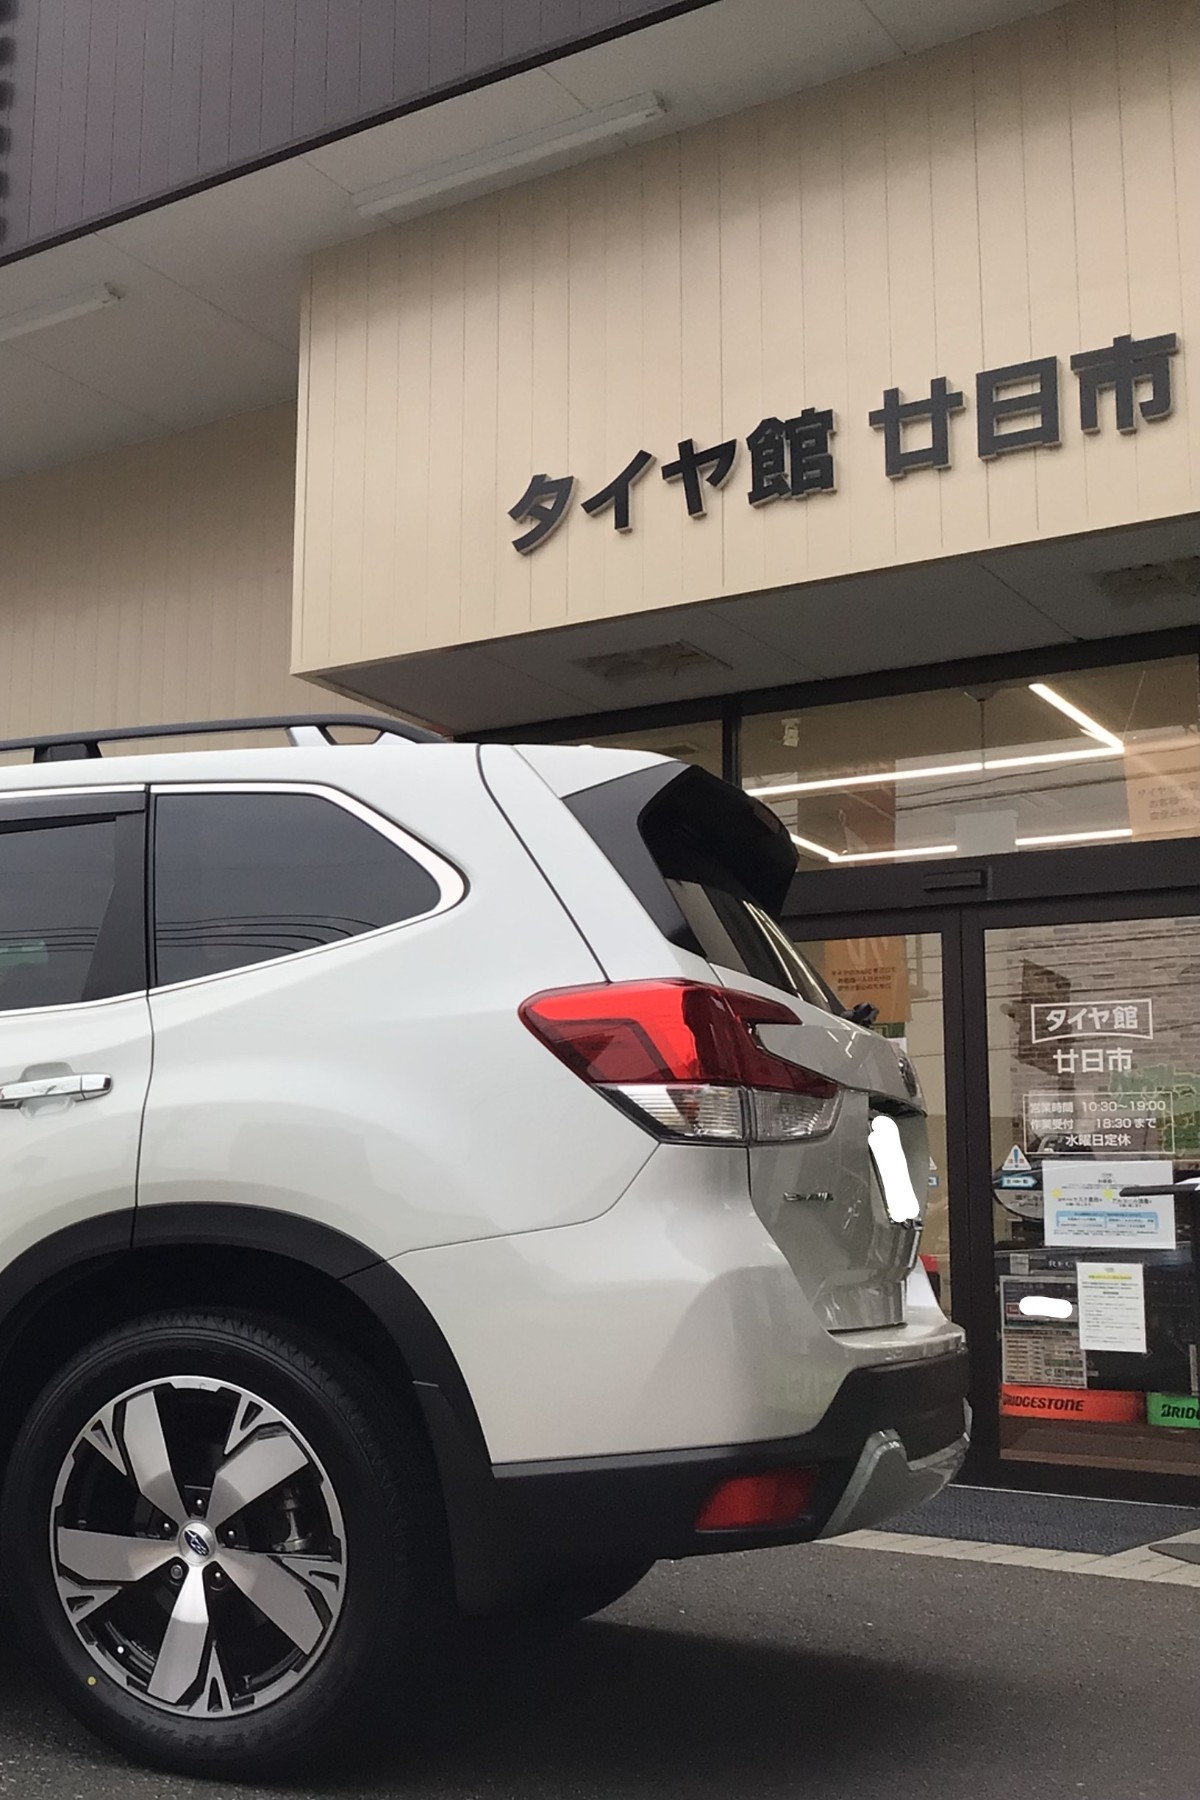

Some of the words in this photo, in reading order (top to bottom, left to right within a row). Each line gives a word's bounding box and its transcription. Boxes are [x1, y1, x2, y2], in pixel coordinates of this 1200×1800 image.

[508, 407, 837, 556] タイヤ館
[868, 332, 1179, 481] 廿日市
[1046, 1005, 1138, 1032] タイヤ館
[1053, 1047, 1133, 1074] 廿日市
[1065, 1134, 1132, 1147] 水曜日定休
